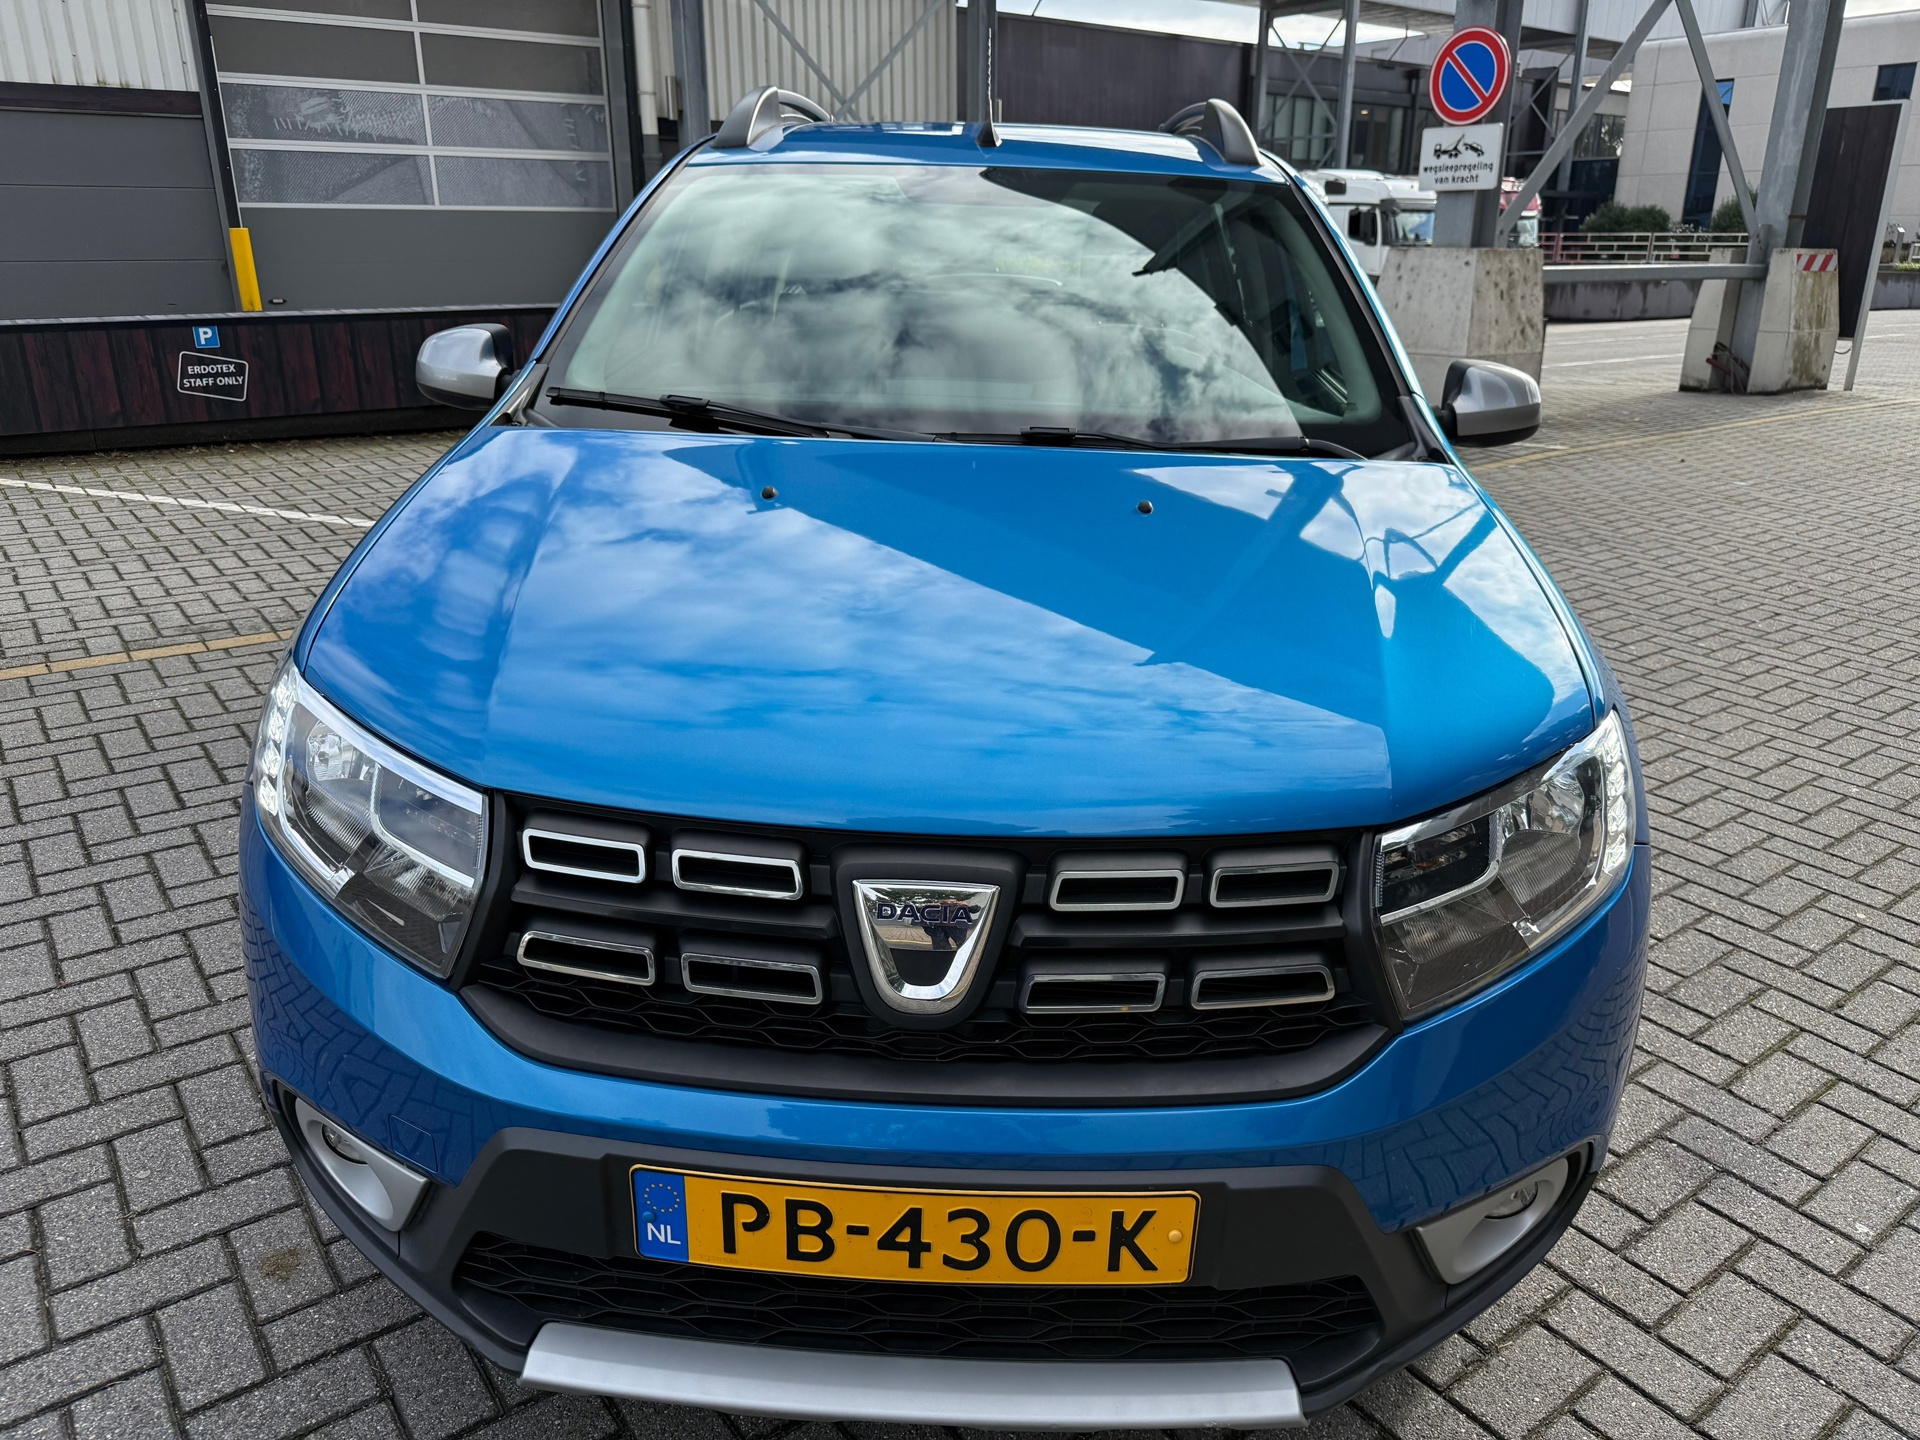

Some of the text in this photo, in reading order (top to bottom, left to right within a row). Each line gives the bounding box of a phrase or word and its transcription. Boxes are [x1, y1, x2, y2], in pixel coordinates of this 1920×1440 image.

[1423, 162, 1493, 175] wegsleepregeling
[1434, 174, 1479, 184] van kracht
[199, 328, 212, 345] P
[187, 364, 236, 374] ERDOTEX
[183, 376, 243, 388] STAFF ONLY
[876, 903, 973, 924] DACIA
[647, 1223, 681, 1245] NL
[721, 1192, 1158, 1272] PB-430-K
